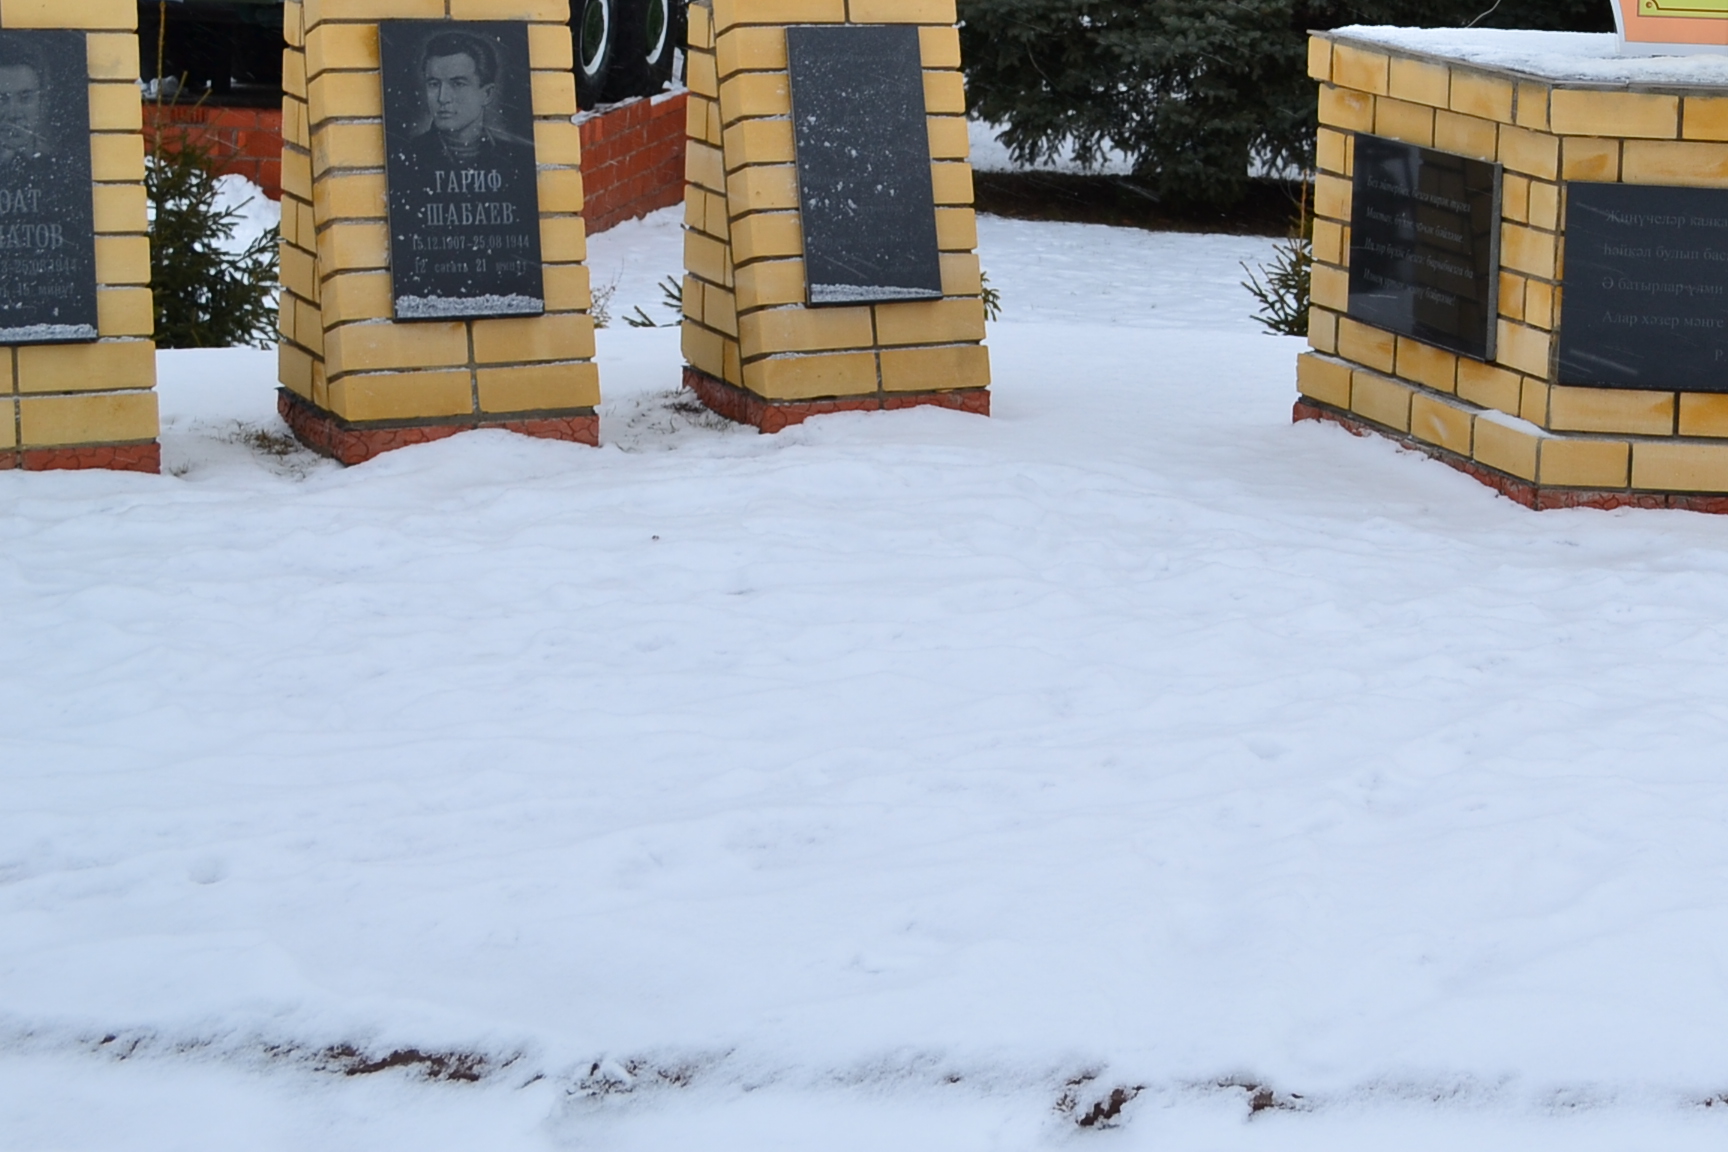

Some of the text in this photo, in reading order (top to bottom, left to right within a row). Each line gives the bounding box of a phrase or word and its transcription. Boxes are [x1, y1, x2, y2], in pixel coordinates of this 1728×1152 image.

[435, 170, 502, 193] ГАРИФ
[426, 202, 514, 226] ШАБАЕВ
[1602, 311, 1638, 327] Алар
